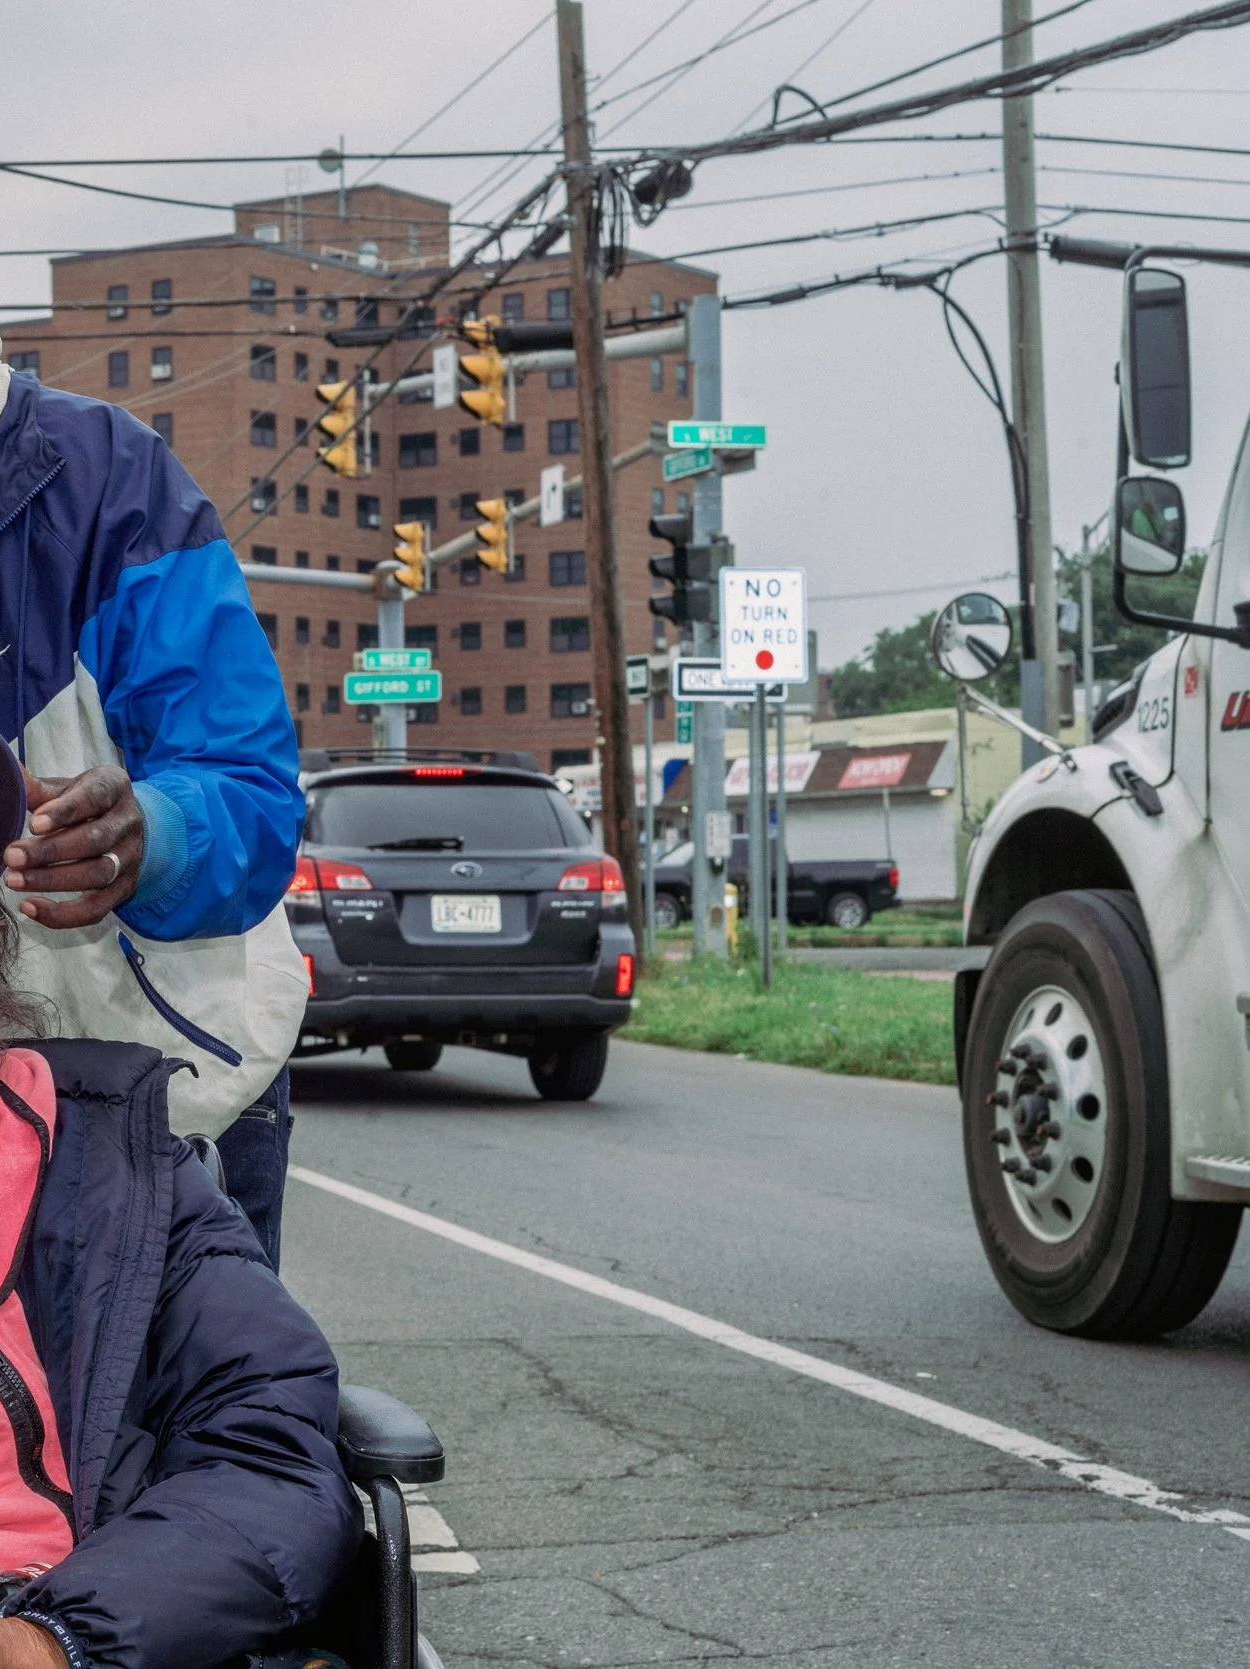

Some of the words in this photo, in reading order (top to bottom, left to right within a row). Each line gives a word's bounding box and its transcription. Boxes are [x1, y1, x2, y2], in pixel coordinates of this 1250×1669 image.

[698, 426, 734, 442] WEST
[744, 578, 782, 598] NO
[740, 605, 789, 622] TURN
[730, 629, 755, 645] ON
[763, 629, 798, 645] RED
[379, 653, 411, 667] WEST
[416, 679, 432, 693] ST
[687, 671, 717, 688] ONE
[1137, 697, 1170, 734] 1225
[17, 1610, 56, 1625] TOMMY
